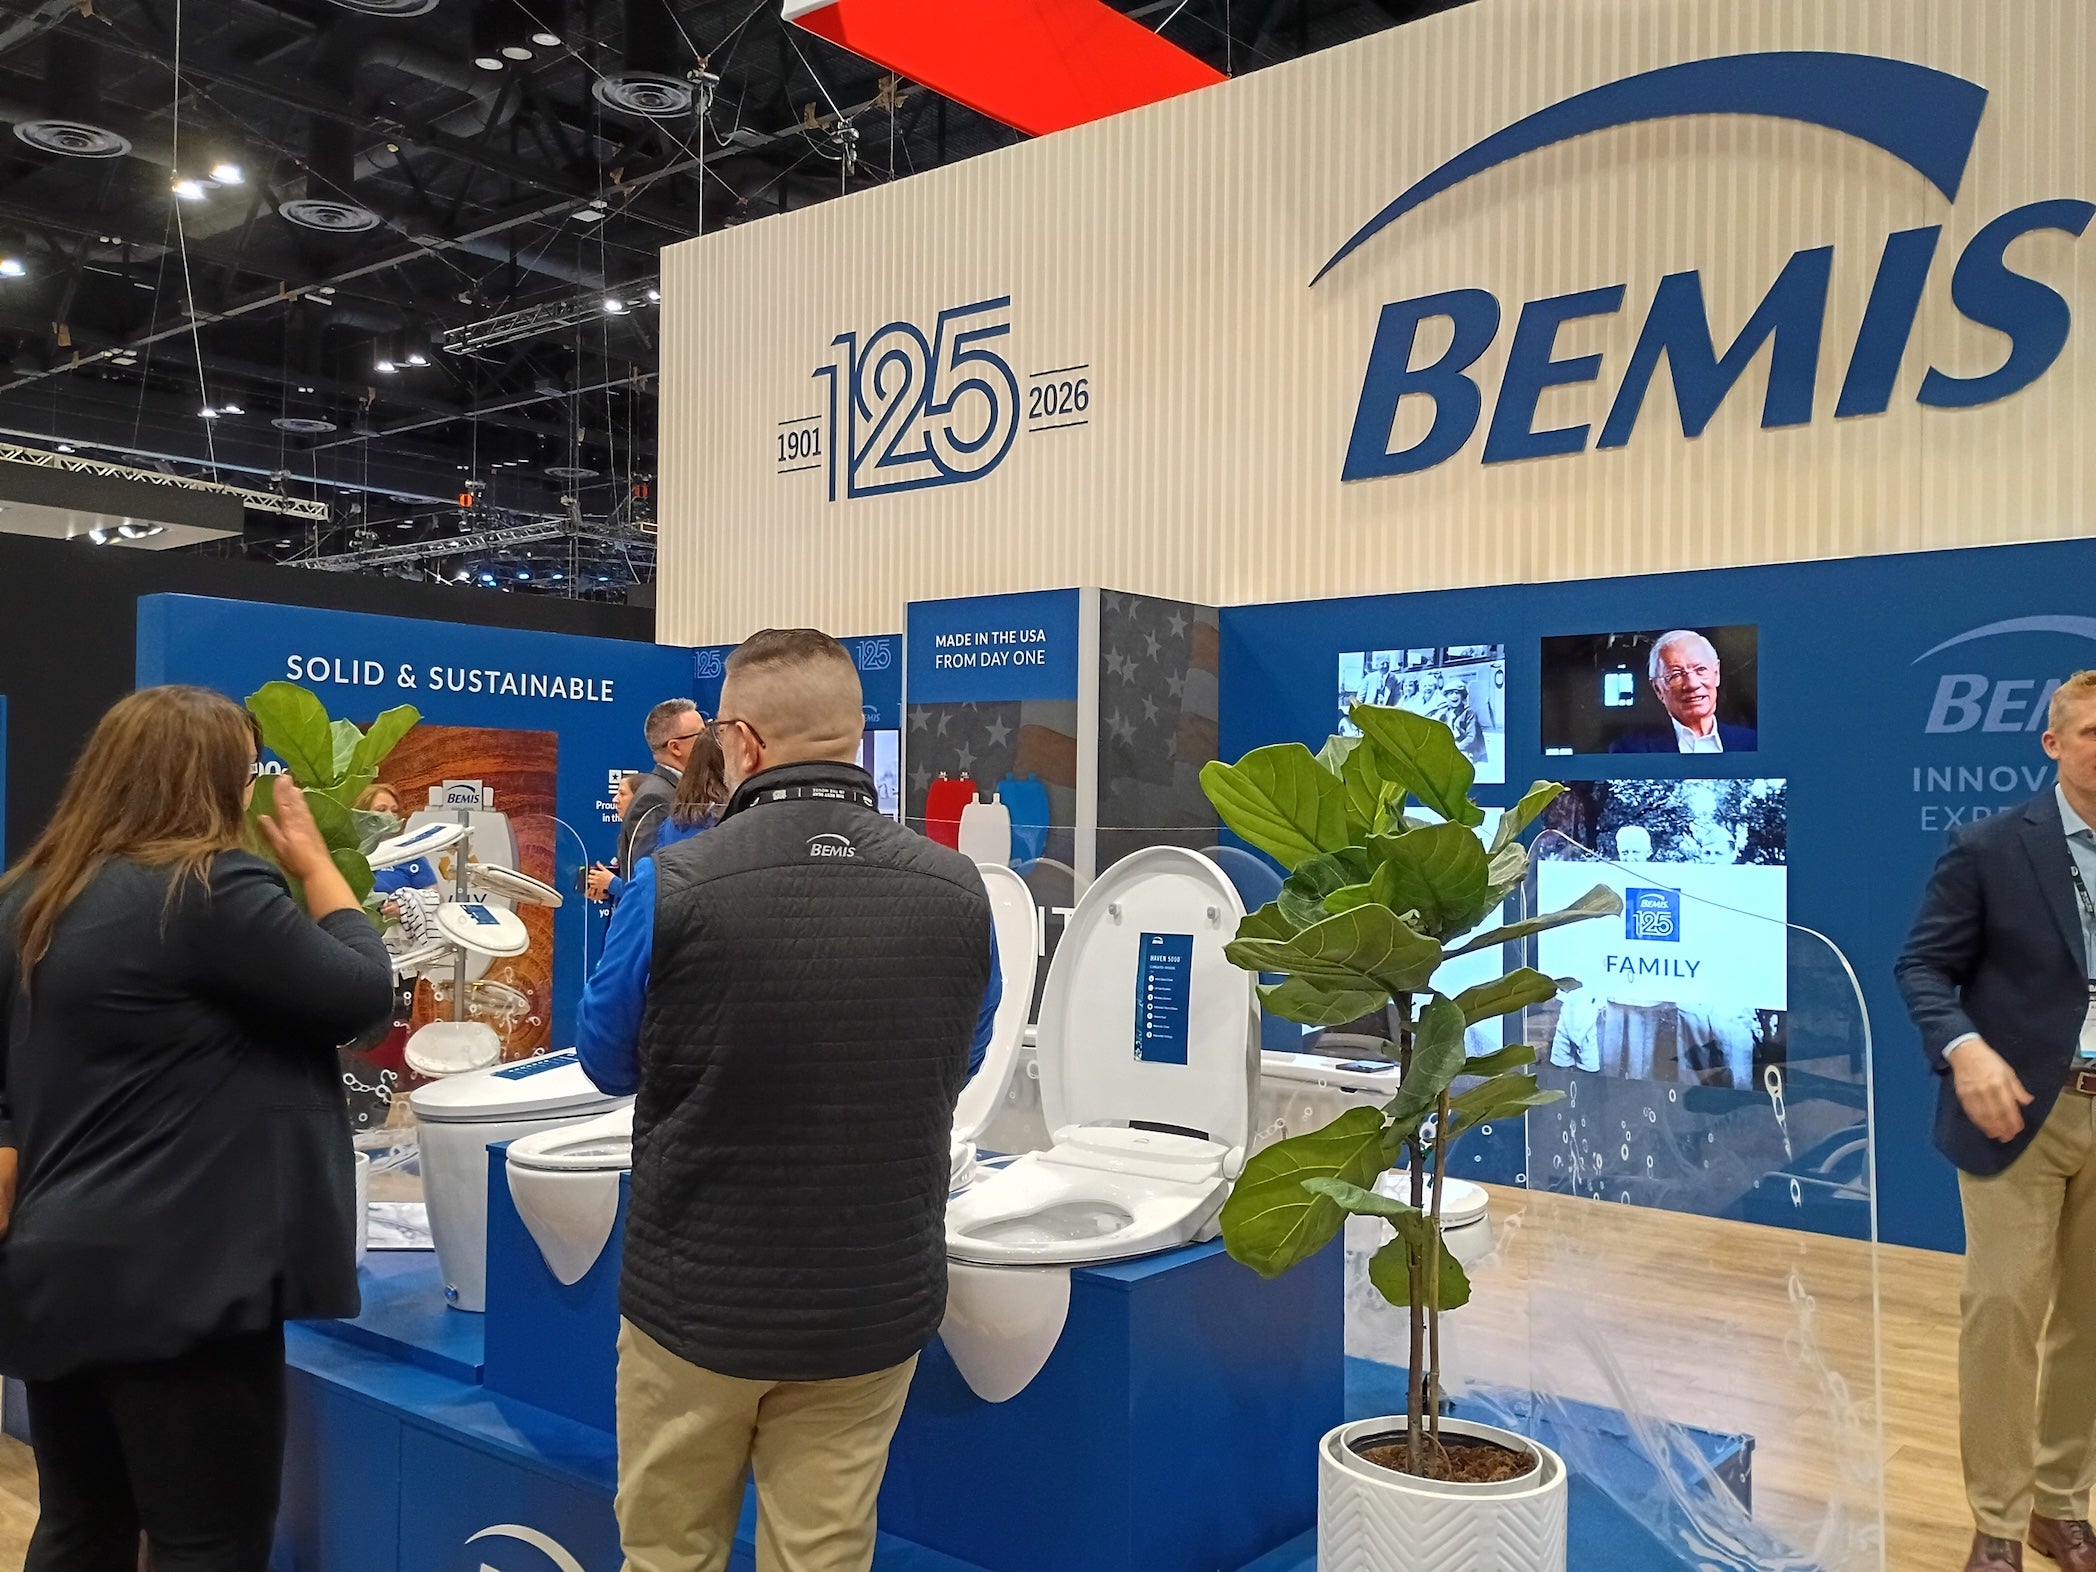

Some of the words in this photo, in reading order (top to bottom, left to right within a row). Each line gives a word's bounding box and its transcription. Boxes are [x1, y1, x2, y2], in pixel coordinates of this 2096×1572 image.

[1340, 197, 2096, 481] BEMIS
[811, 295, 1021, 502] 125
[1028, 378, 1089, 419] 2026
[777, 427, 822, 462] 1901
[935, 634, 972, 648] MADE
[975, 632, 988, 646] IN
[991, 630, 1017, 645] THE
[1020, 628, 1046, 643] USA
[693, 649, 722, 679] 125
[856, 639, 892, 671] 125
[935, 652, 976, 669] FROM
[981, 651, 1010, 667] DAY
[1013, 649, 1046, 665] ONE
[286, 654, 385, 686] SOLID
[397, 664, 417, 689] &
[429, 666, 614, 702] SUSTAINABLE
[1913, 765, 2059, 792] INNOV
[447, 792, 480, 804] BEMIS
[595, 800, 618, 810] Prou
[602, 813, 611, 822] in
[612, 813, 623, 822] th
[810, 843, 856, 857] BEMIS
[1640, 899, 1669, 909] BEMIS
[1633, 910, 1674, 938] 125
[1607, 955, 1700, 978] FAMILY
